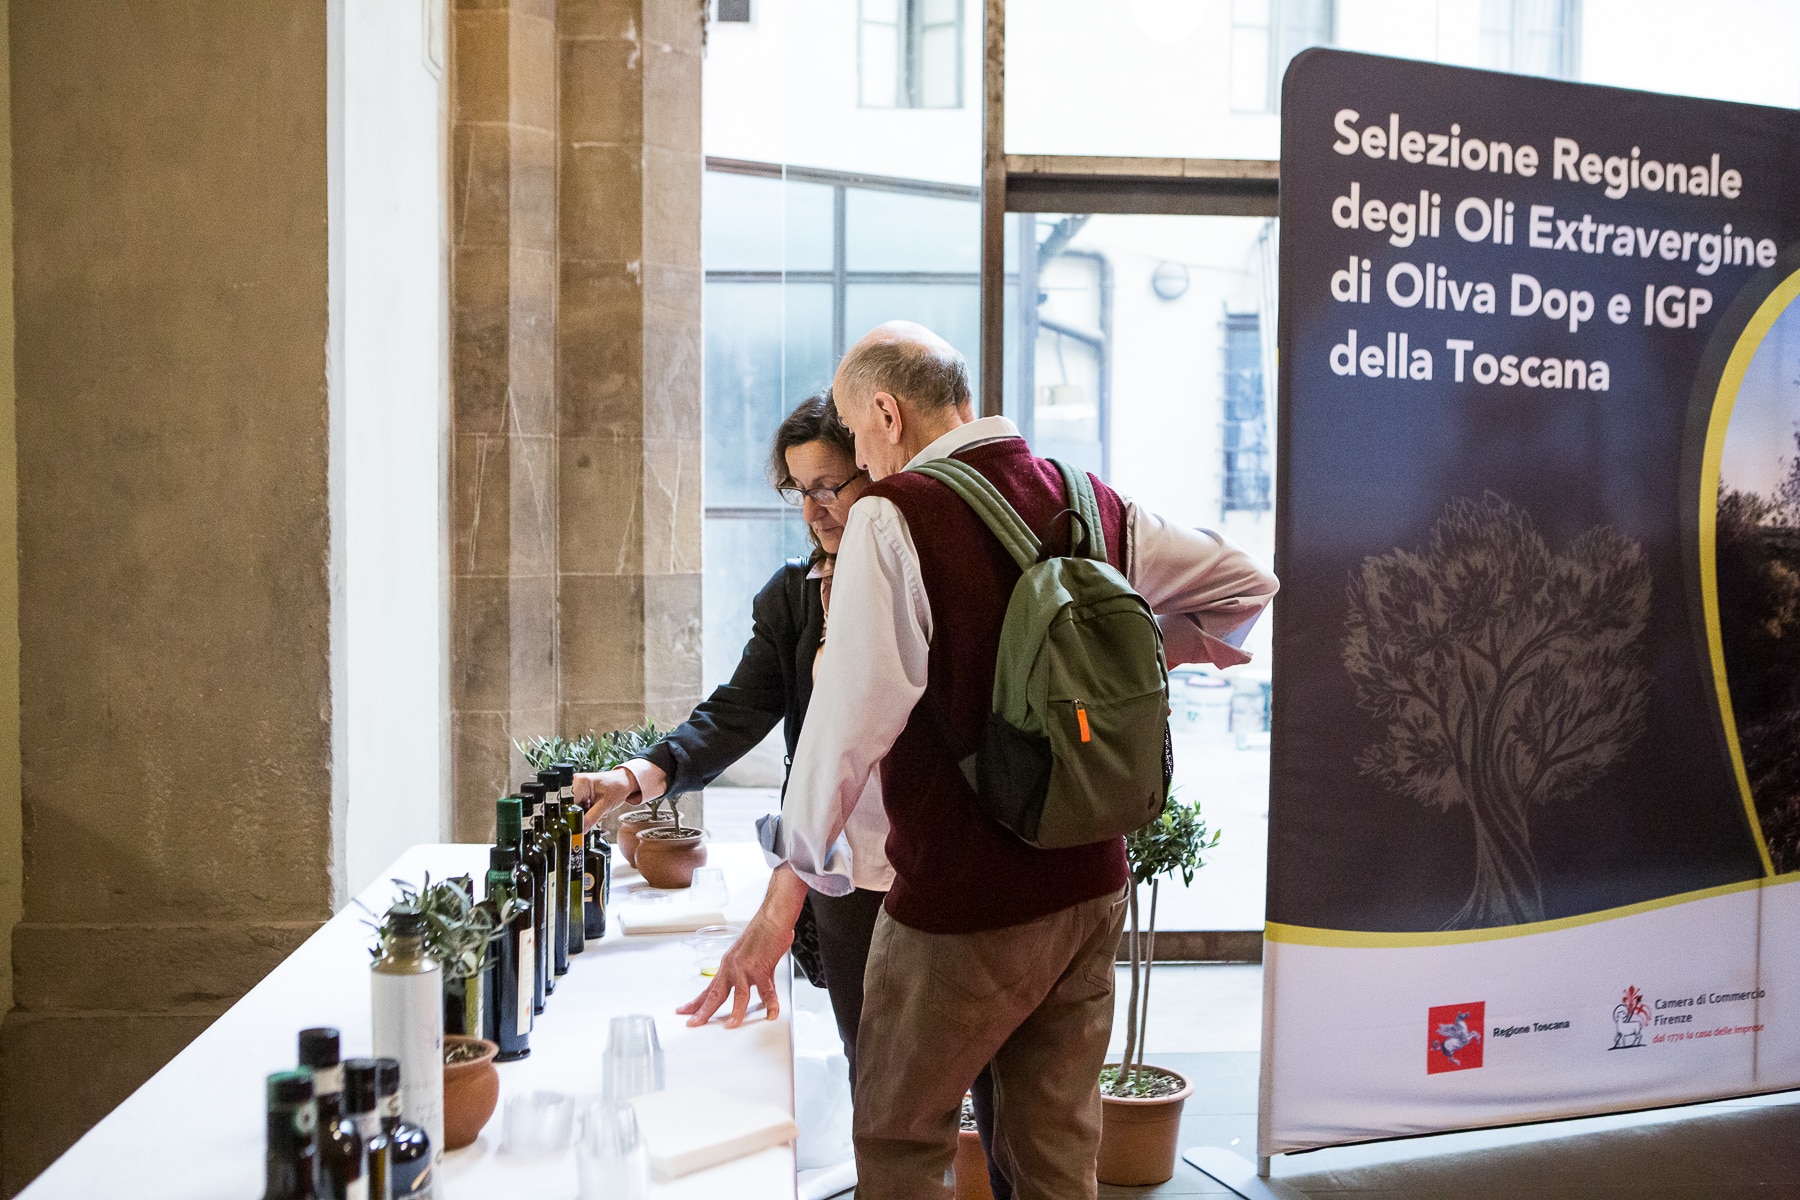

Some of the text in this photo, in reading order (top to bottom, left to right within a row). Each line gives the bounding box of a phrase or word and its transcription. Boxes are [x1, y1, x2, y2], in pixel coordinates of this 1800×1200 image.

[1332, 108, 1742, 200] Selezione Regionale
[1331, 181, 1778, 276] degli Oli Extravergine
[1330, 255, 1713, 333] di Oliva Dop e IGP
[1329, 328, 1610, 391] della Toscana
[1655, 988, 1766, 1010] Camera di Commercio
[1493, 1021, 1570, 1038] Regione Toscana
[1653, 1033, 1665, 1044] dal
[1714, 1026, 1733, 1037] delle
[1654, 1014, 1693, 1027] Firenze
